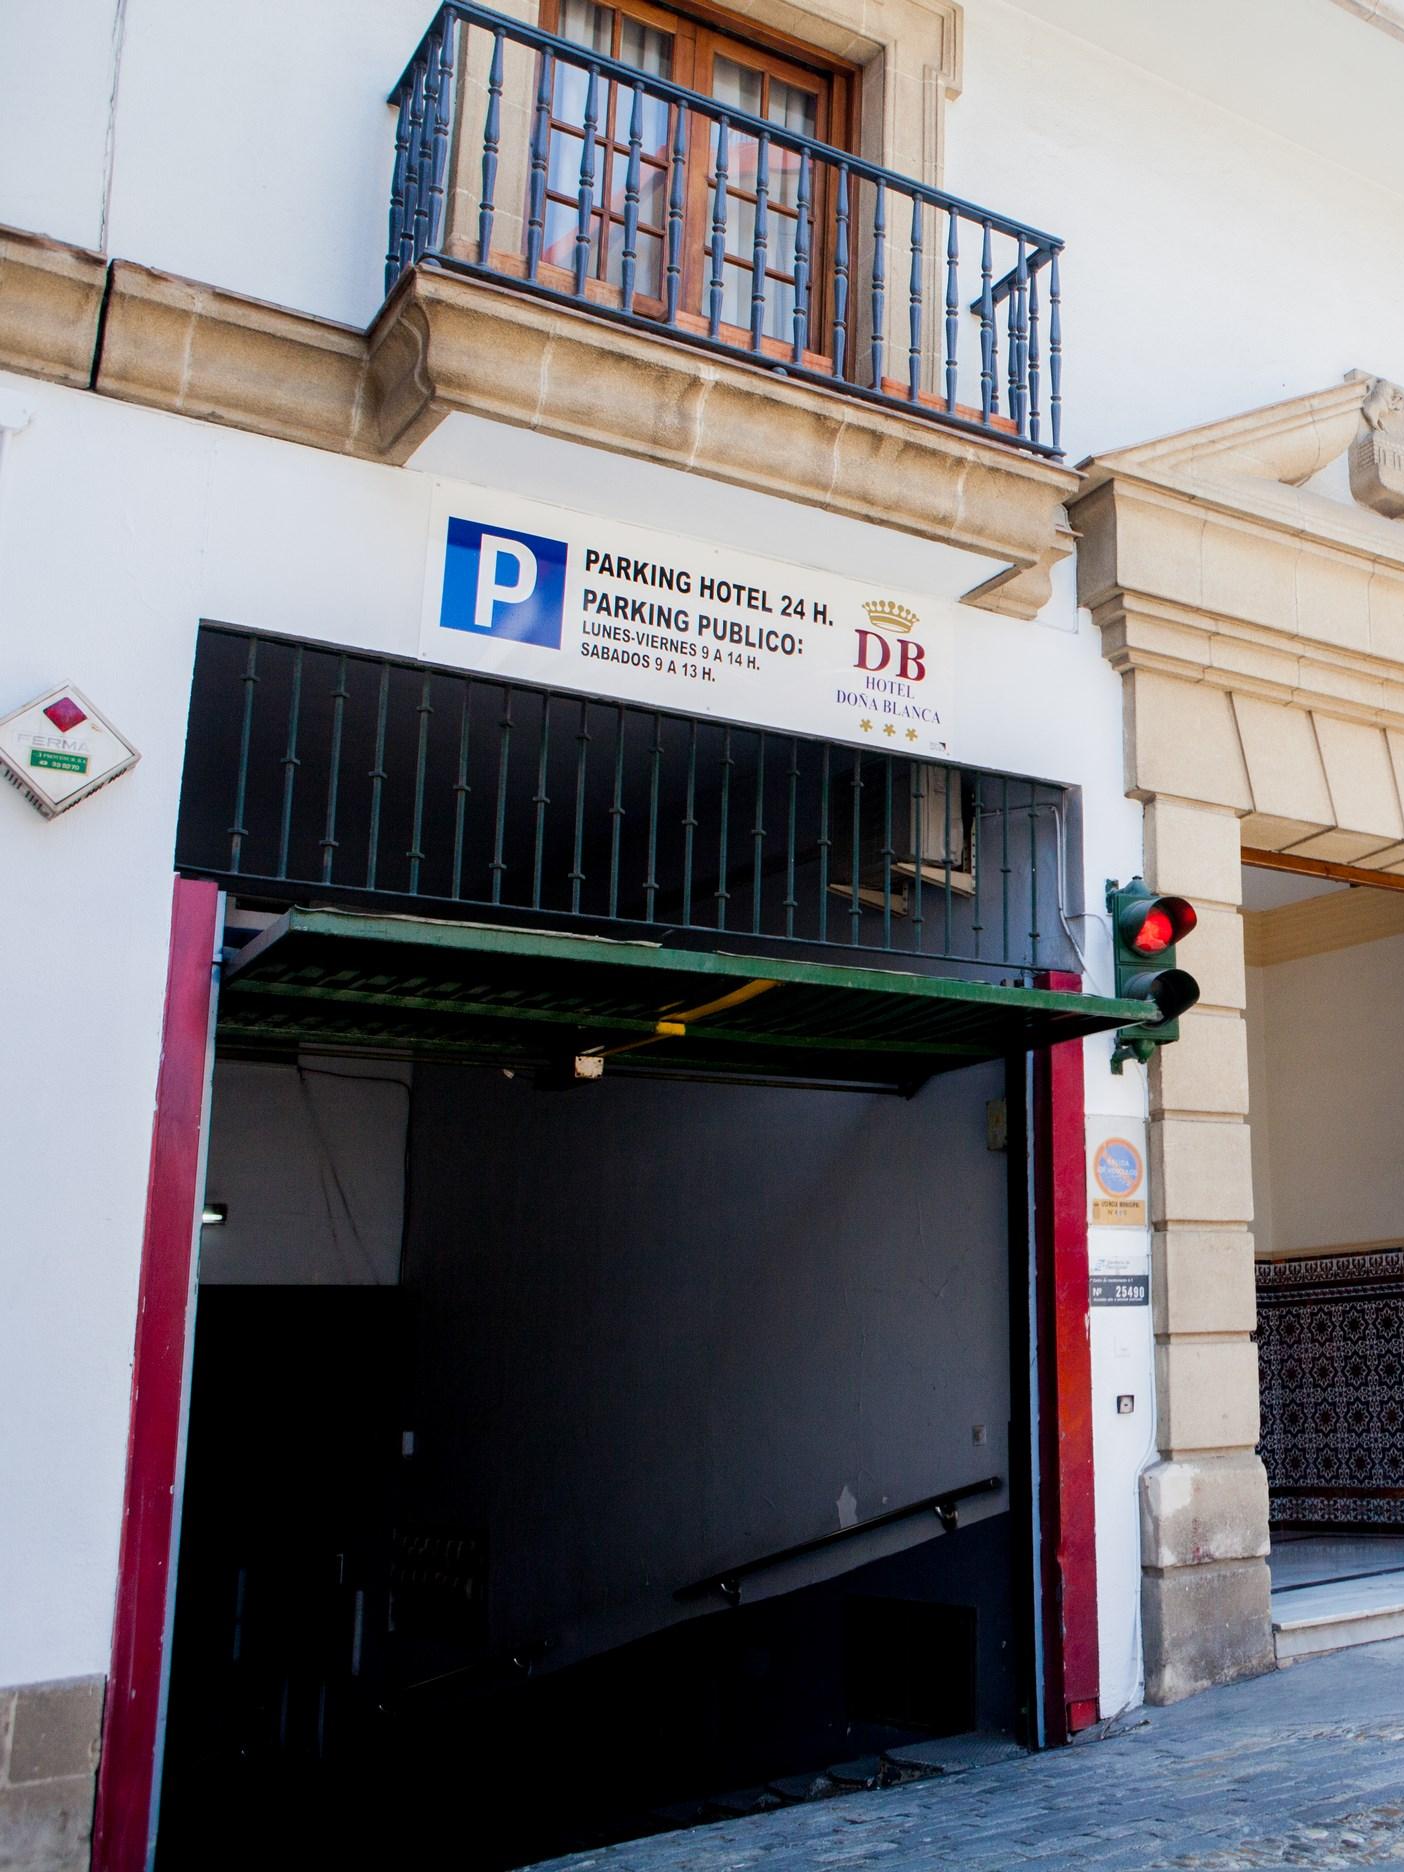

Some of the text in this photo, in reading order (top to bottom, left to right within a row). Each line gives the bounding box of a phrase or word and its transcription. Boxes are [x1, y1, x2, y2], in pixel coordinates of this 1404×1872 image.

[474, 533, 538, 628] P
[586, 549, 834, 627] PARKING HOTEL 24 H.
[583, 589, 804, 656] PARKING PUBLICO:
[581, 641, 716, 682] SABADOS 9 A 13 H.
[582, 621, 760, 671] LUNES-VIERNES 9 A 14 H.
[837, 690, 941, 724] DOÑA BLANCA
[866, 676, 915, 699] HOTEL
[1115, 1285, 1145, 1298] 25490
